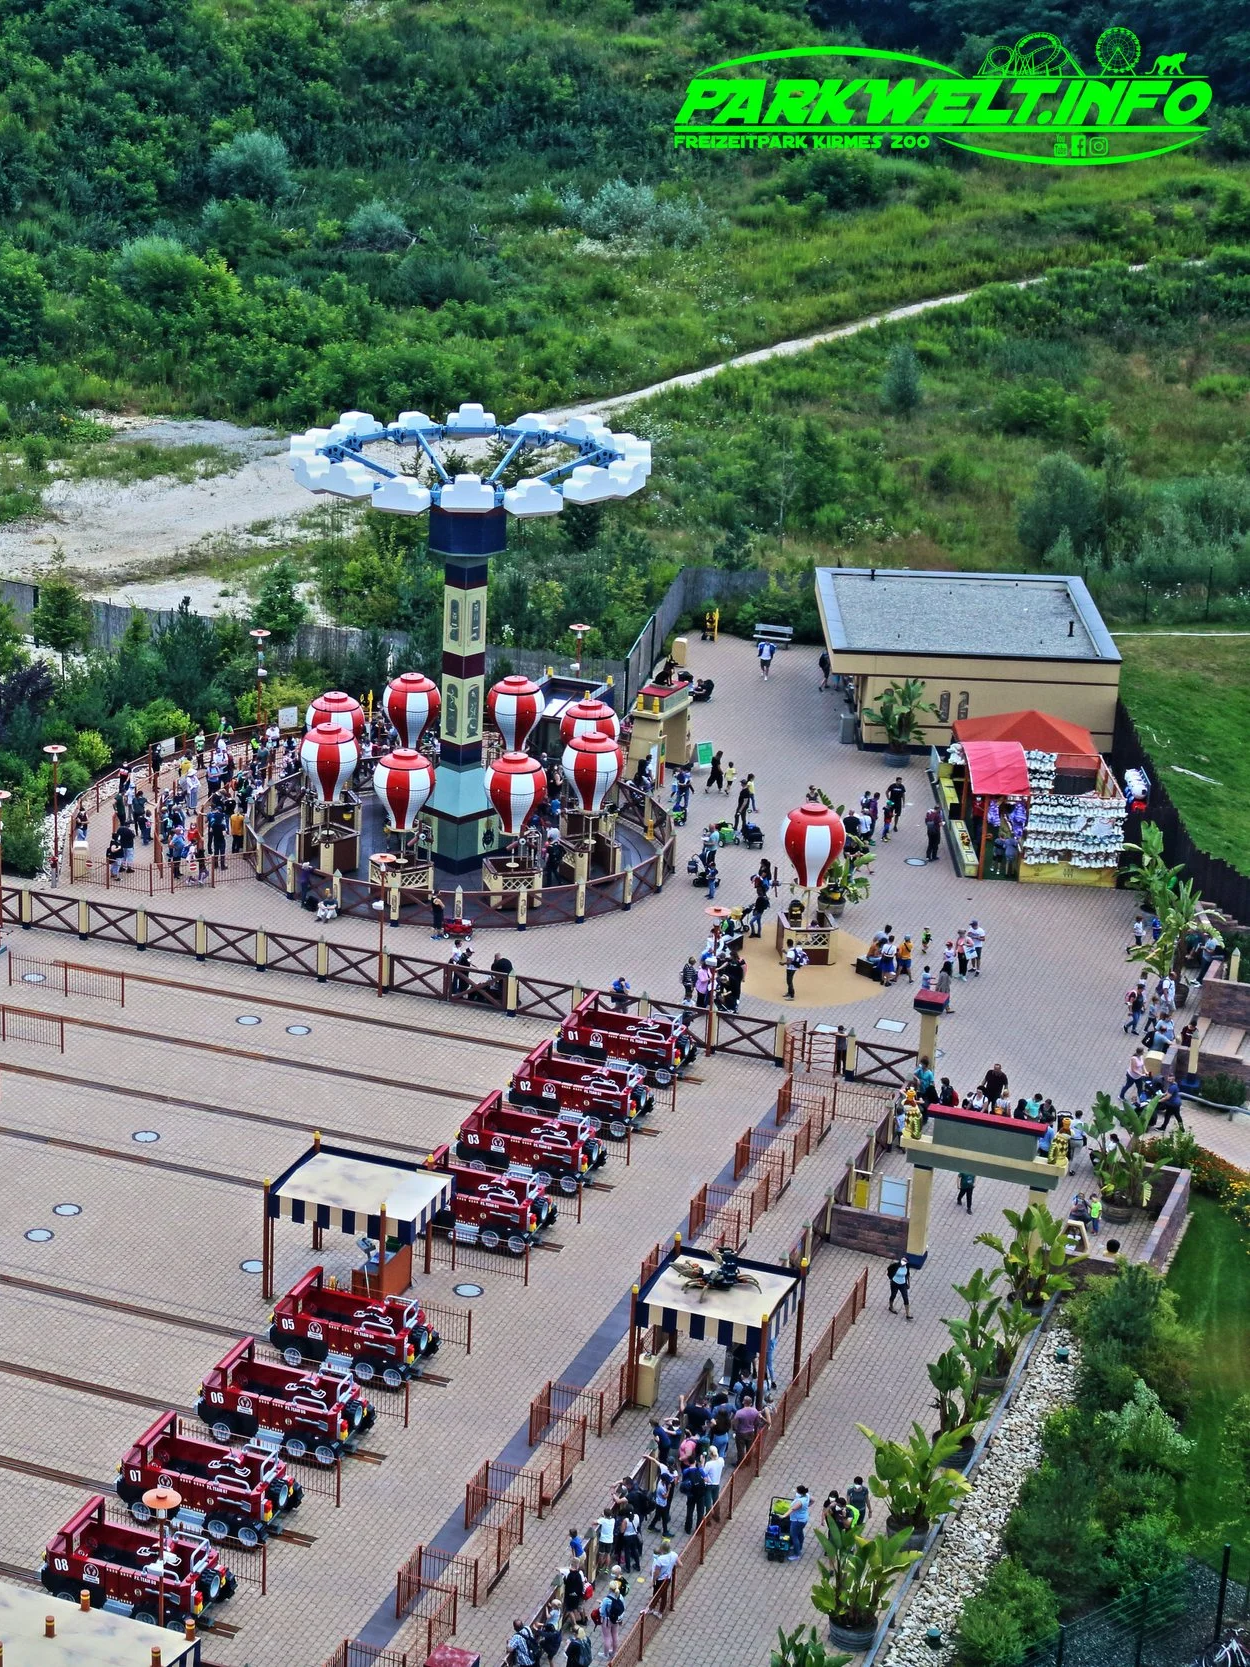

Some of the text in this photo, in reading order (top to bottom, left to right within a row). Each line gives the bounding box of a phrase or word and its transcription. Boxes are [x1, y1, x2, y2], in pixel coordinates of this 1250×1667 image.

[567, 1030, 579, 1041] 01
[519, 1081, 532, 1091] 02
[467, 1134, 480, 1145] 03
[281, 1318, 295, 1330] 05
[210, 1391, 225, 1404] 06
[129, 1469, 142, 1482] 07
[54, 1558, 69, 1571] 08
